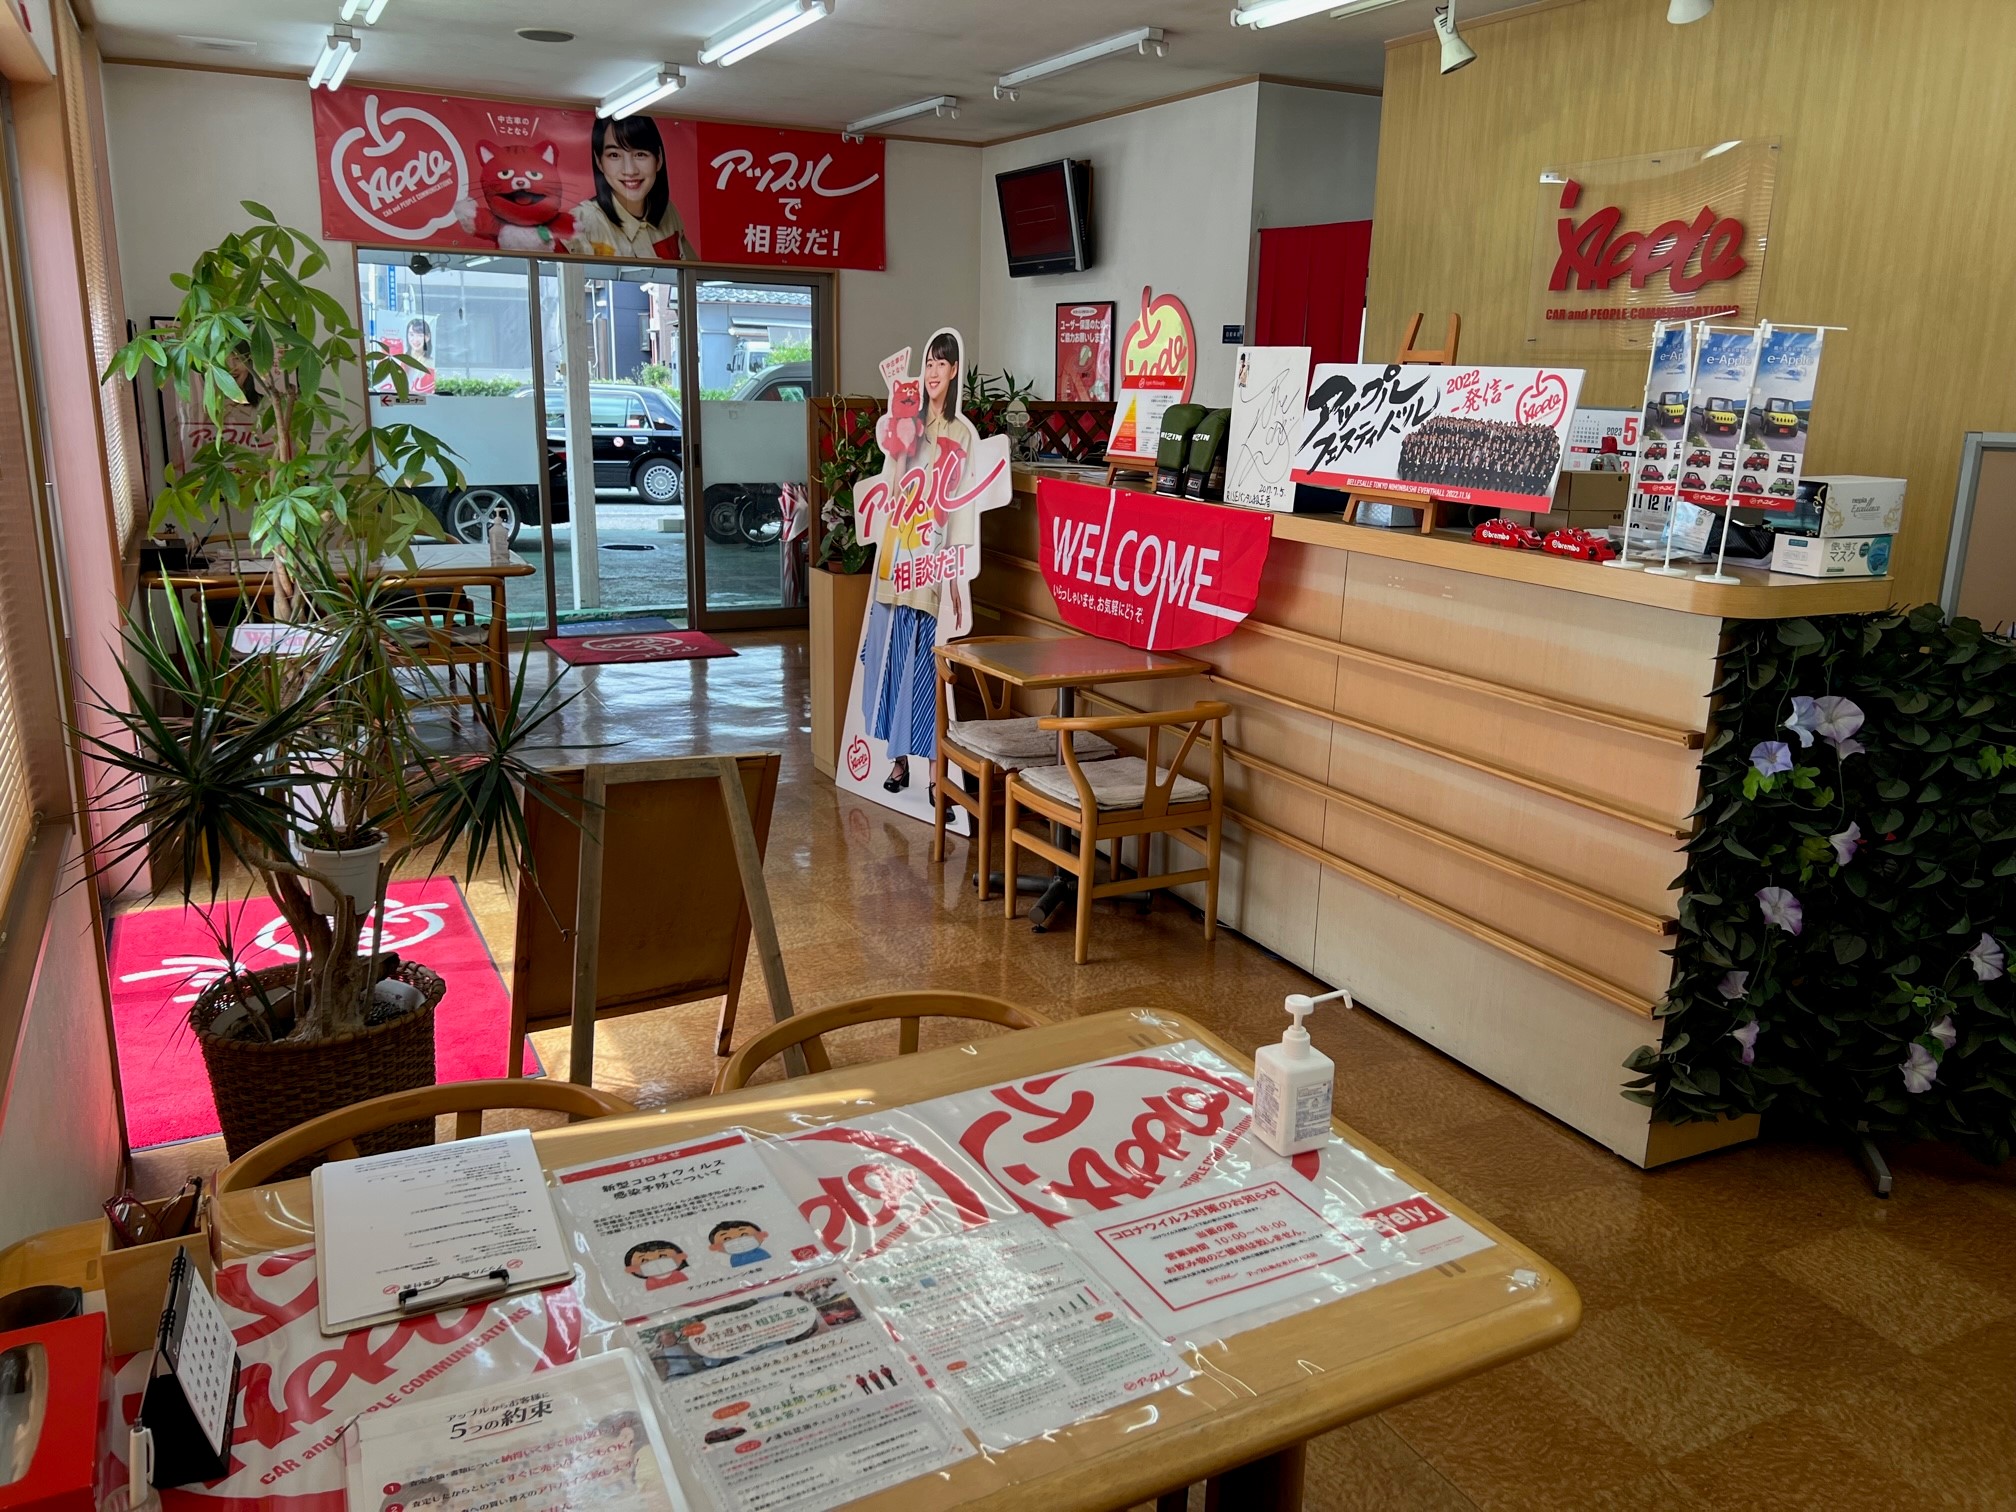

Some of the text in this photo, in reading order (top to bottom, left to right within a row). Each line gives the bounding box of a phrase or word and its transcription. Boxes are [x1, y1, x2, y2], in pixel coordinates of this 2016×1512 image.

[497, 115, 530, 125] 中古車の
[499, 126, 529, 136] ことなら
[710, 149, 880, 197] アップル
[382, 210, 395, 218] CAR
[778, 197, 803, 221] で
[1546, 308, 1566, 321] CAR
[1568, 307, 1588, 321] and
[1590, 307, 1628, 321] PEOPLE
[1767, 353, 1814, 367] e-Apple
[1446, 369, 1481, 395] 2022
[1606, 427, 1623, 437] 2023
[1622, 417, 1639, 446] 5
[857, 450, 1007, 538] アップル
[1372, 480, 1388, 490] TOKYO
[1647, 494, 1660, 511] 12
[916, 522, 935, 546] で
[1489, 530, 1511, 542] brembo
[1558, 541, 1580, 552] brembo
[1829, 551, 1857, 562] マスク
[1053, 489, 1249, 632] WELCOME
[629, 1150, 681, 1168] お知らせ
[613, 1168, 724, 1200] 感染予防について
[1108, 1187, 1281, 1242] コロナウイルス対策のお知らせ
[260, 1459, 302, 1485] CAR
[302, 1436, 335, 1460] and
[400, 1306, 533, 1395] COMMUNICATIONS
[445, 1391, 551, 1423] アップルからお客様に
[450, 1399, 554, 1440] 5つの約束
